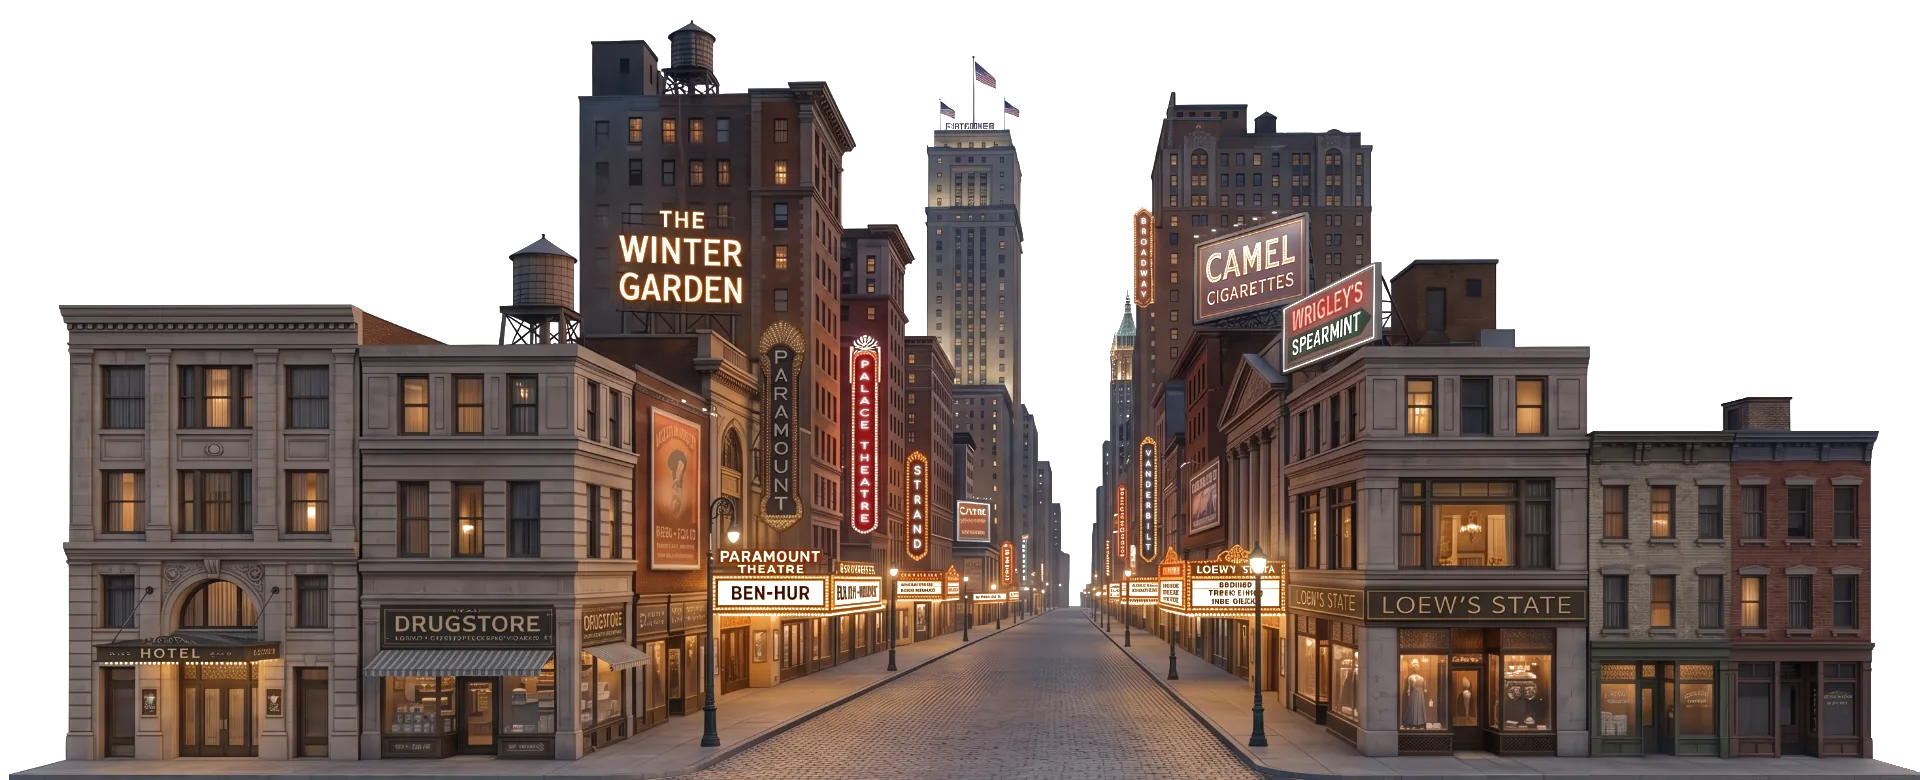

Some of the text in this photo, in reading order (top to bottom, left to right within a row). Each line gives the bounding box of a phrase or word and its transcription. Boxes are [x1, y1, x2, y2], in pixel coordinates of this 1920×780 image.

[659, 210, 705, 229] THE
[618, 234, 743, 267] WINTER
[1140, 217, 1148, 298] BROADWAY
[1205, 234, 1296, 283] CAMEL
[619, 272, 743, 304] GARDEN
[1206, 271, 1295, 306] CIGARETTES
[1291, 281, 1364, 332] WRIGLEY'S
[1291, 311, 1362, 356] SPEARMINT
[774, 350, 789, 511] PARAMOUNT
[859, 360, 871, 523] PALACE THEATRE
[913, 465, 922, 549] STRAND
[720, 550, 821, 563] PARAMOUNT
[737, 564, 804, 574] THEATRE
[731, 585, 810, 601] BEN-HUR
[1327, 592, 1356, 612] STATE
[1382, 596, 1572, 615] LOEW'S STATE
[395, 615, 541, 633] DRUGSTORE
[140, 648, 200, 659] HOTEL
